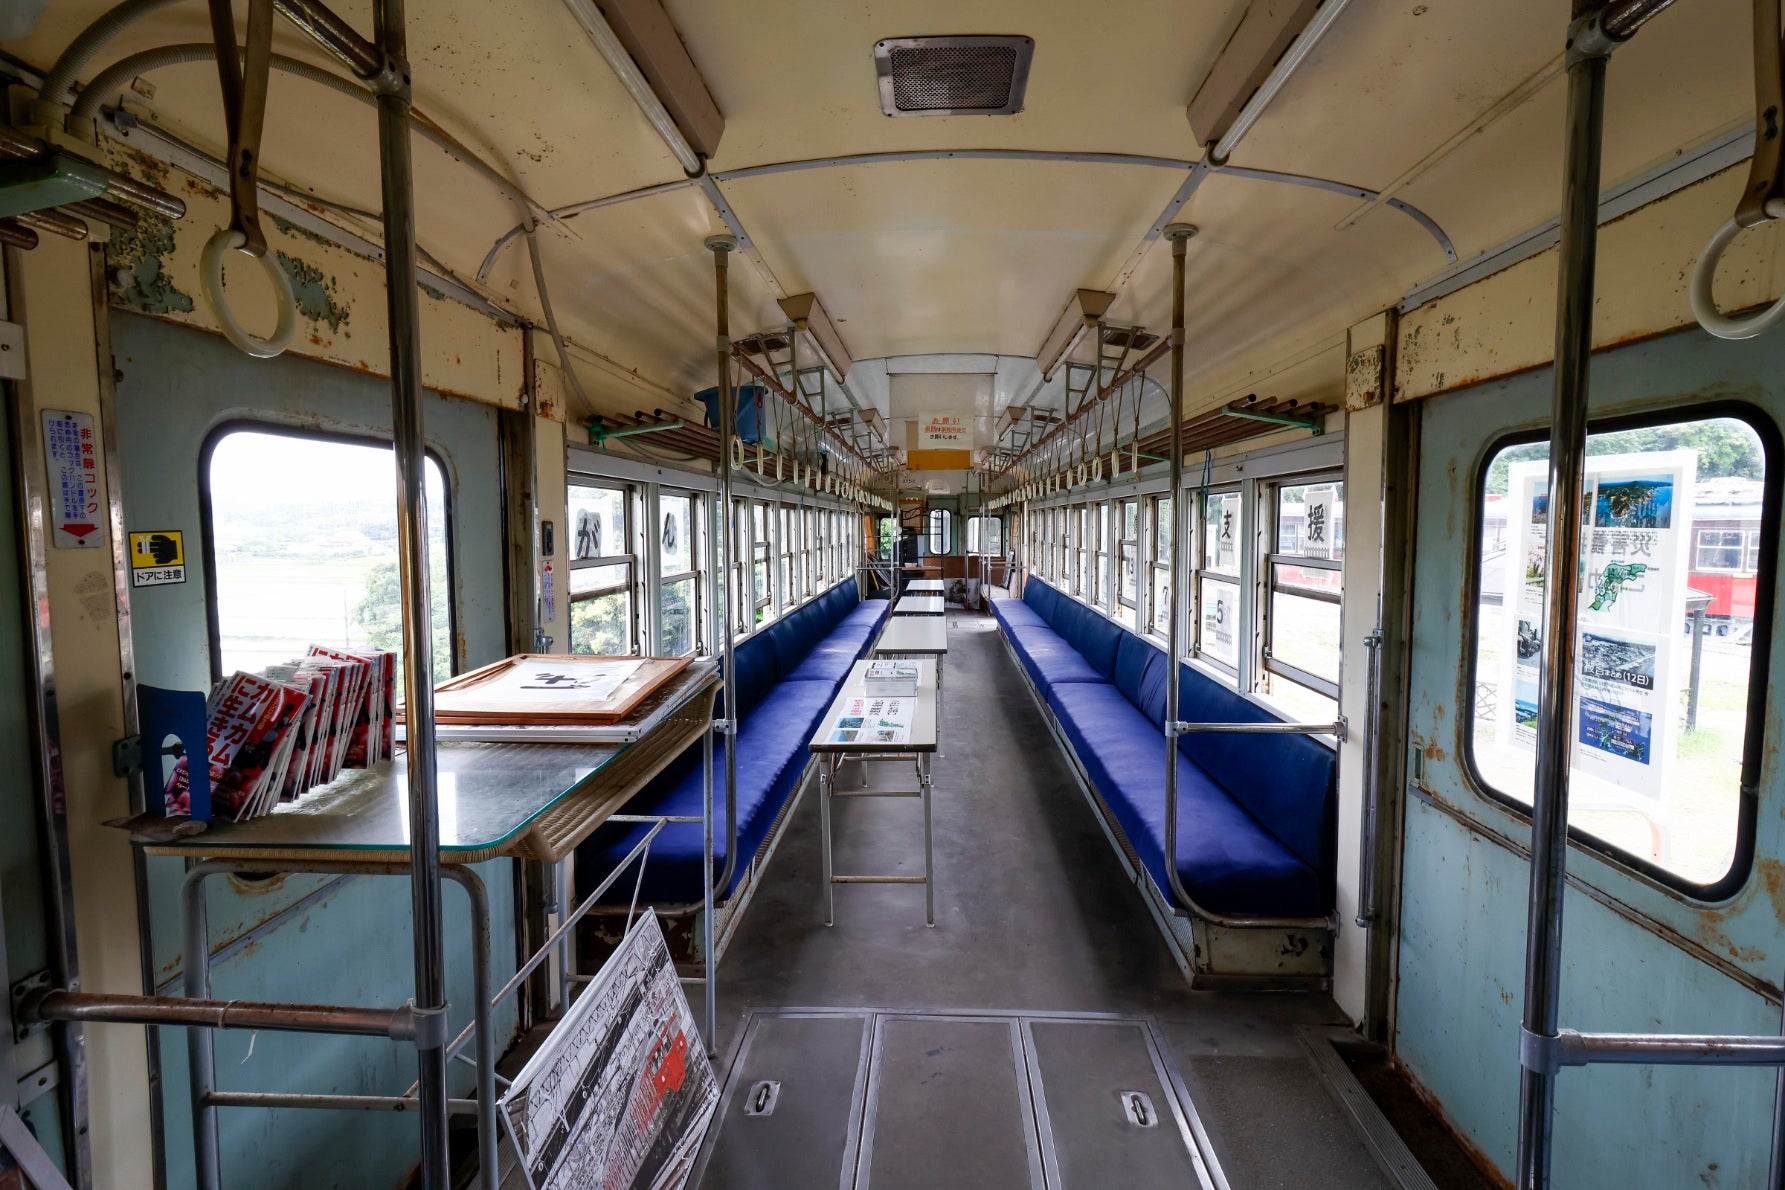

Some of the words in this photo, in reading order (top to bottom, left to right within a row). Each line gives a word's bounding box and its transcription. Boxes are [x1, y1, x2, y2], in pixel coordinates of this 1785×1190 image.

[80, 428, 98, 514] 非常扉コック
[576, 517, 601, 559] が
[662, 511, 676, 548] ん
[1221, 509, 1232, 539] 支
[1308, 504, 1325, 543] 援
[136, 569, 183, 583] ドアに注意
[1216, 599, 1225, 625] 5
